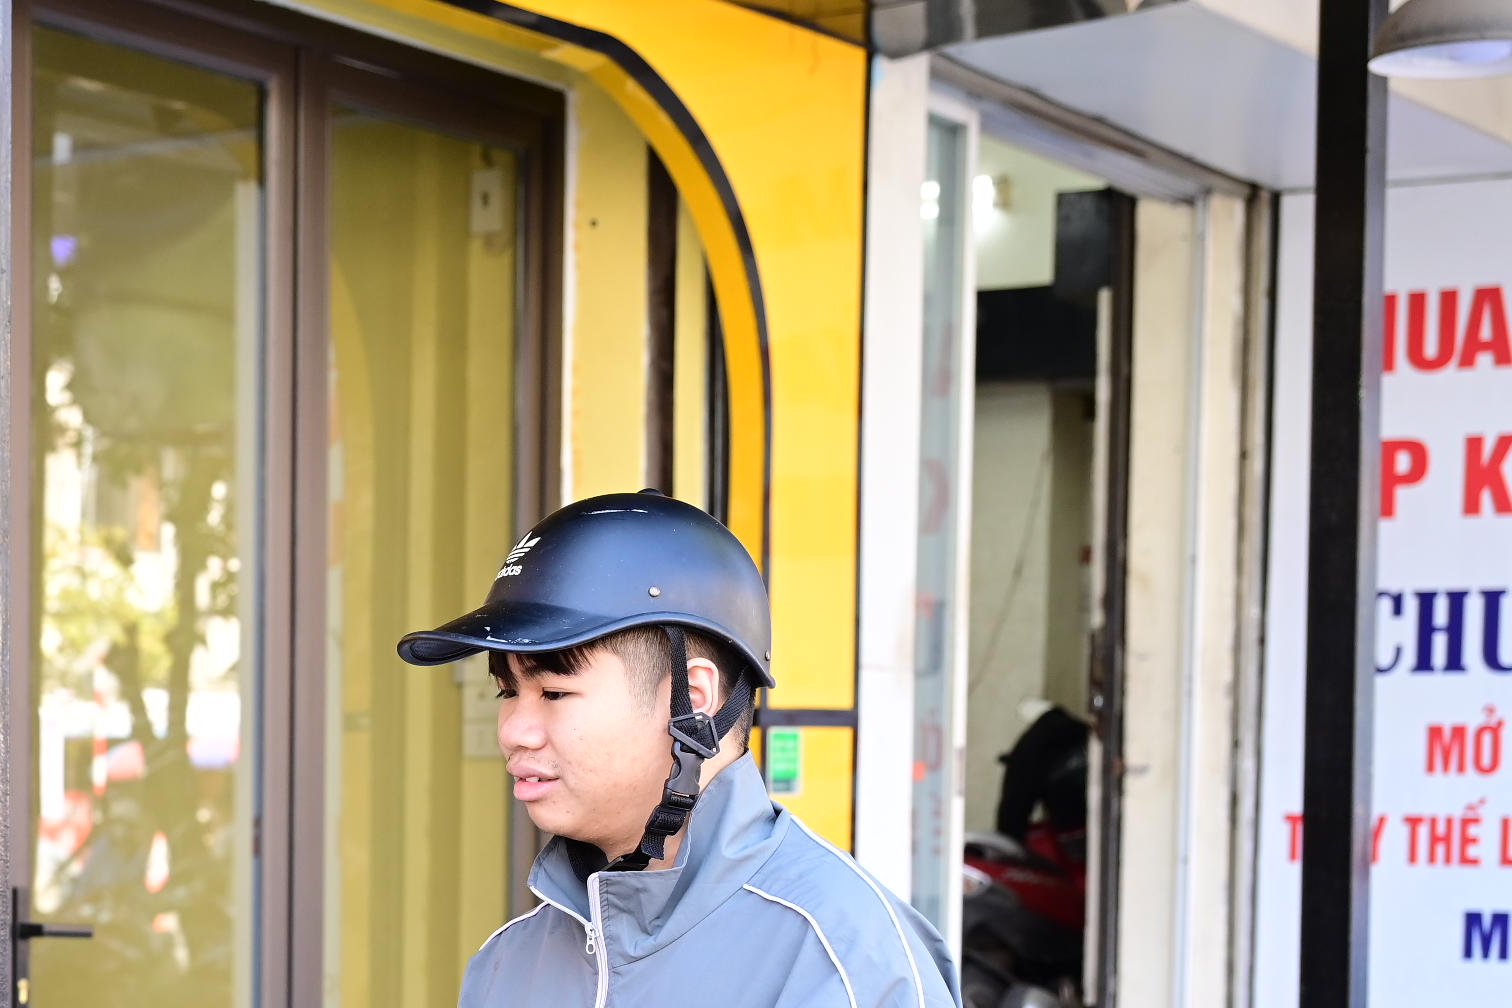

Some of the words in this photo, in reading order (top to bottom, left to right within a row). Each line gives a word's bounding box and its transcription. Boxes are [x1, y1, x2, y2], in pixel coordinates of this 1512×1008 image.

[1382, 286, 1512, 373] UA
[1425, 704, 1506, 775] MỞ
[1403, 798, 1482, 866] THẾ
